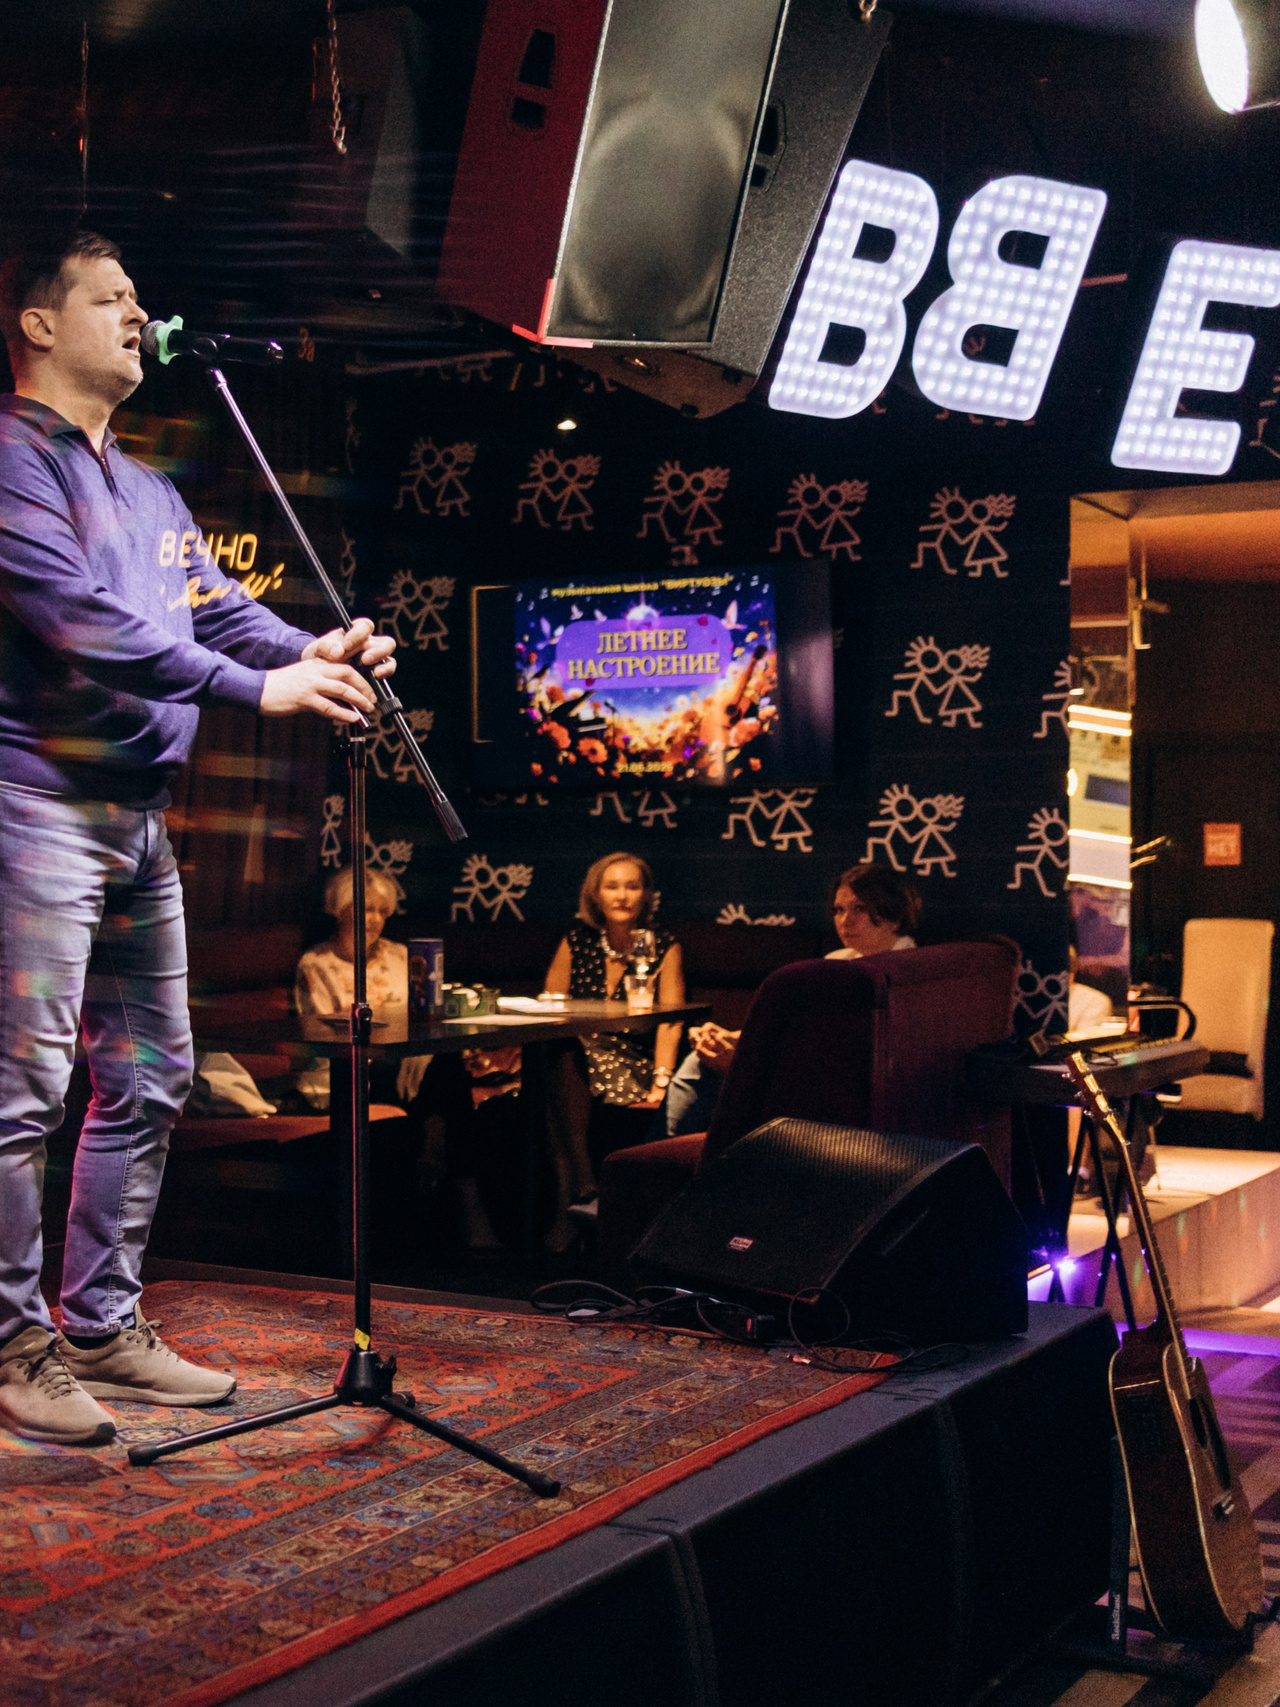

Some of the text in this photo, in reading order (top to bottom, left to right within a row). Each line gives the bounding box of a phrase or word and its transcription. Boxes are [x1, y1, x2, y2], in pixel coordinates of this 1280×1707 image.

[158, 529, 259, 571] ВЕЧНО
[596, 628, 688, 654] ЛЕТНЕЕ
[568, 652, 722, 680] НАСТРОЕНИЕ
